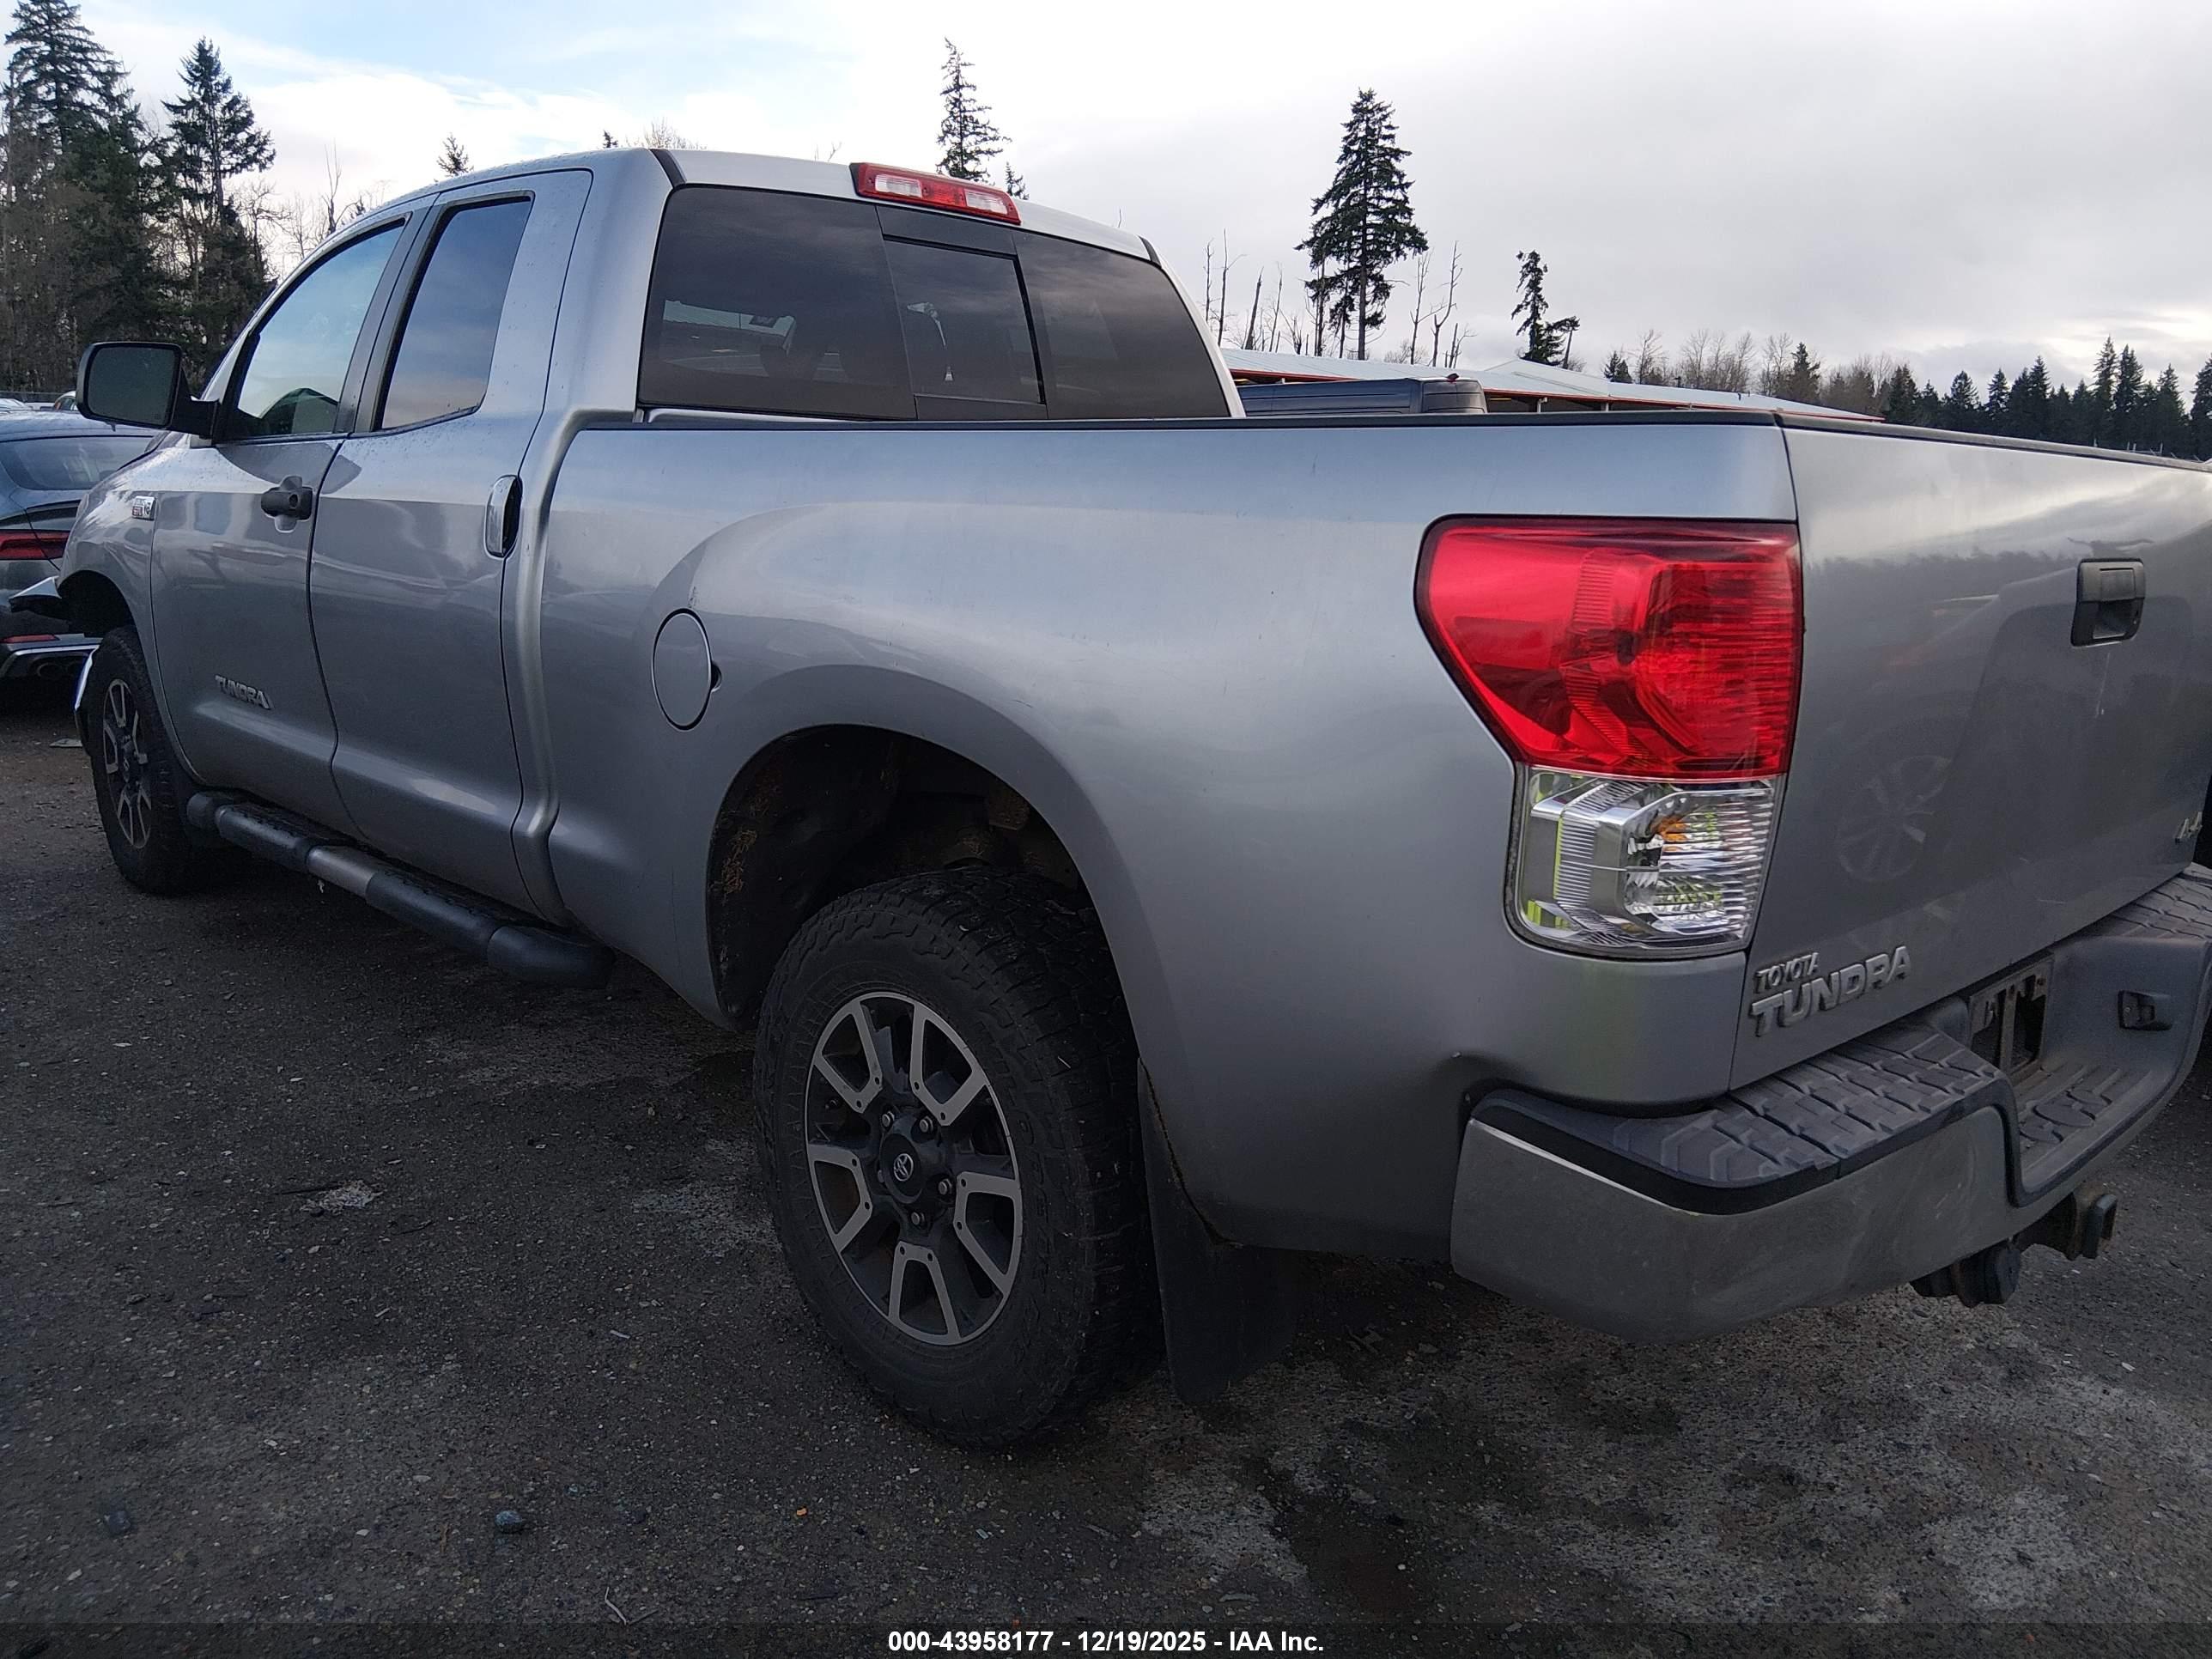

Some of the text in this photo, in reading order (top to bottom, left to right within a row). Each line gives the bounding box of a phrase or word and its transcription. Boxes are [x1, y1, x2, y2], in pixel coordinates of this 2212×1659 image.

[214, 674, 272, 710] TUNDRA
[1749, 945, 1911, 1037] TUNDRA
[1754, 952, 1819, 993] TOYOTA
